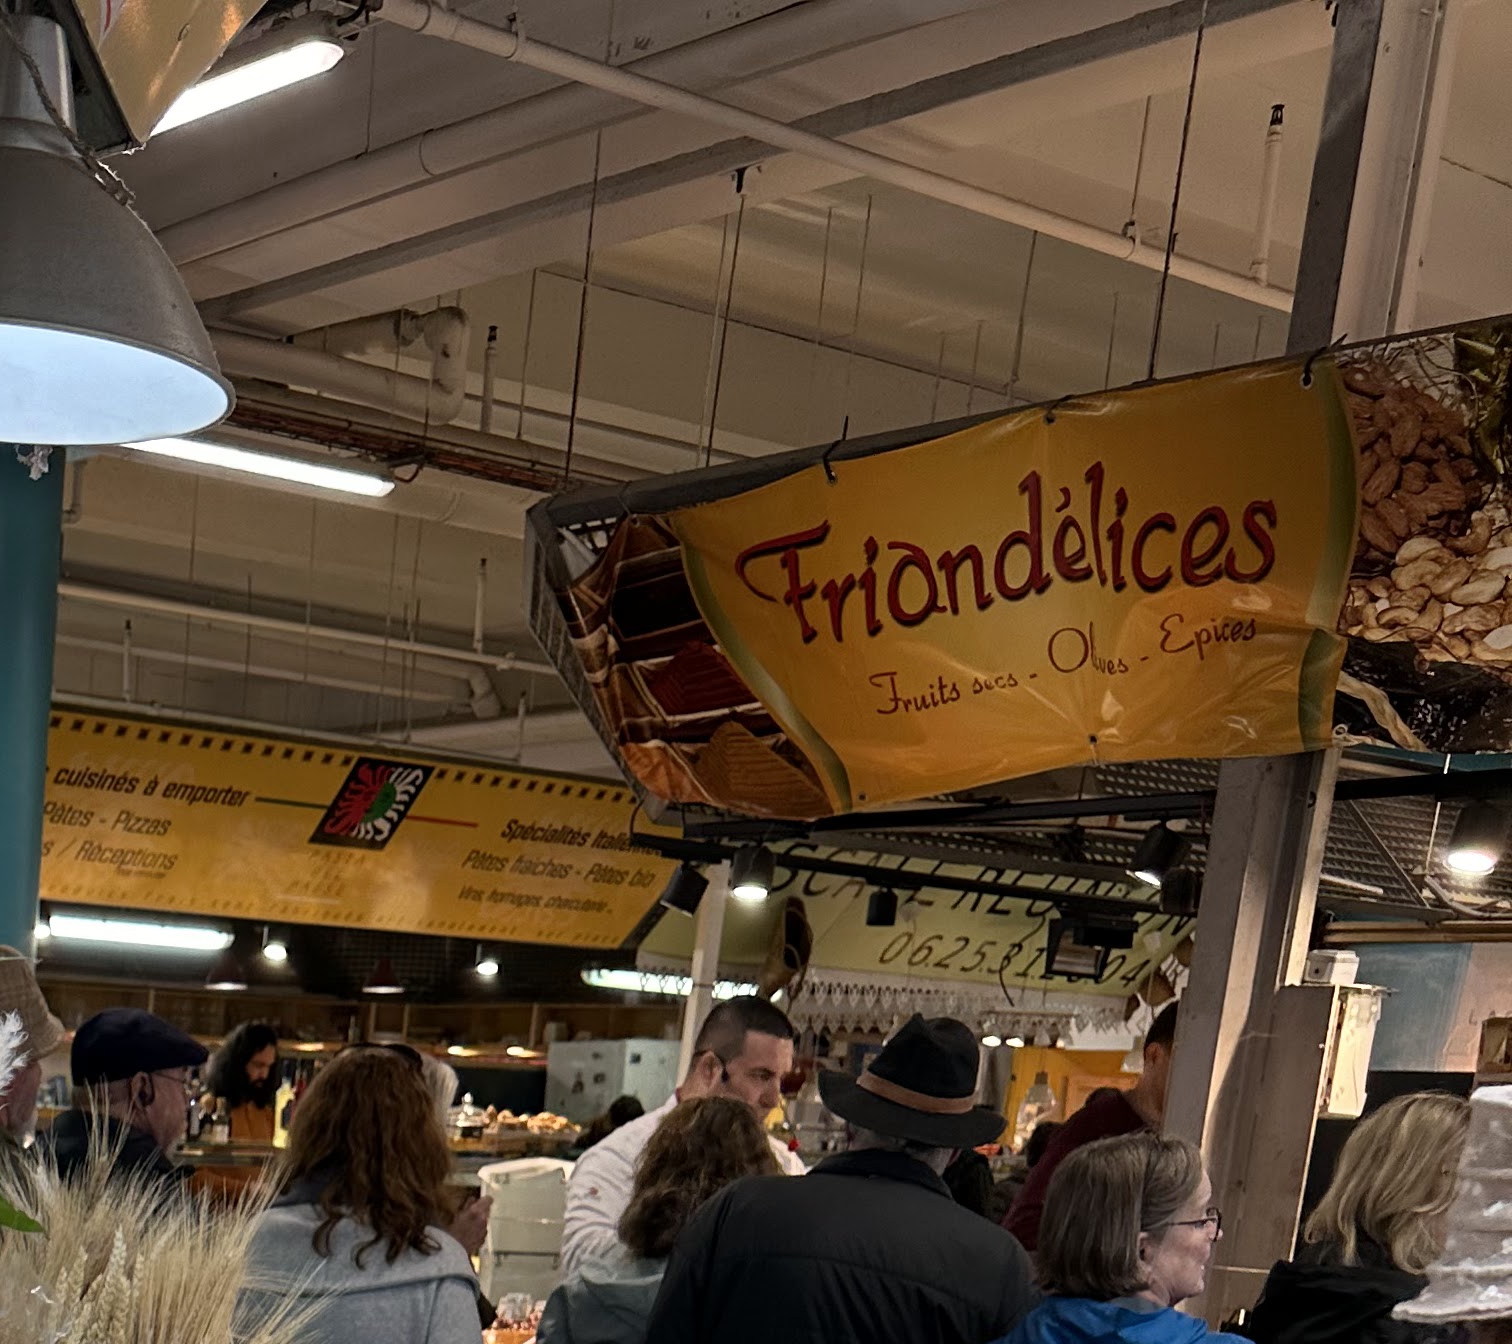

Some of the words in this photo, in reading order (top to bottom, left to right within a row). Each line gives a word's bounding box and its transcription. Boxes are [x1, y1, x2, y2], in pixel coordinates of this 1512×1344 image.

[869, 671, 961, 715] Fruits
[972, 673, 1019, 695] secs
[53, 766, 140, 794] cuisinés
[144, 774, 159, 797] à
[162, 780, 250, 808] emporter
[112, 809, 172, 836] Pizzas
